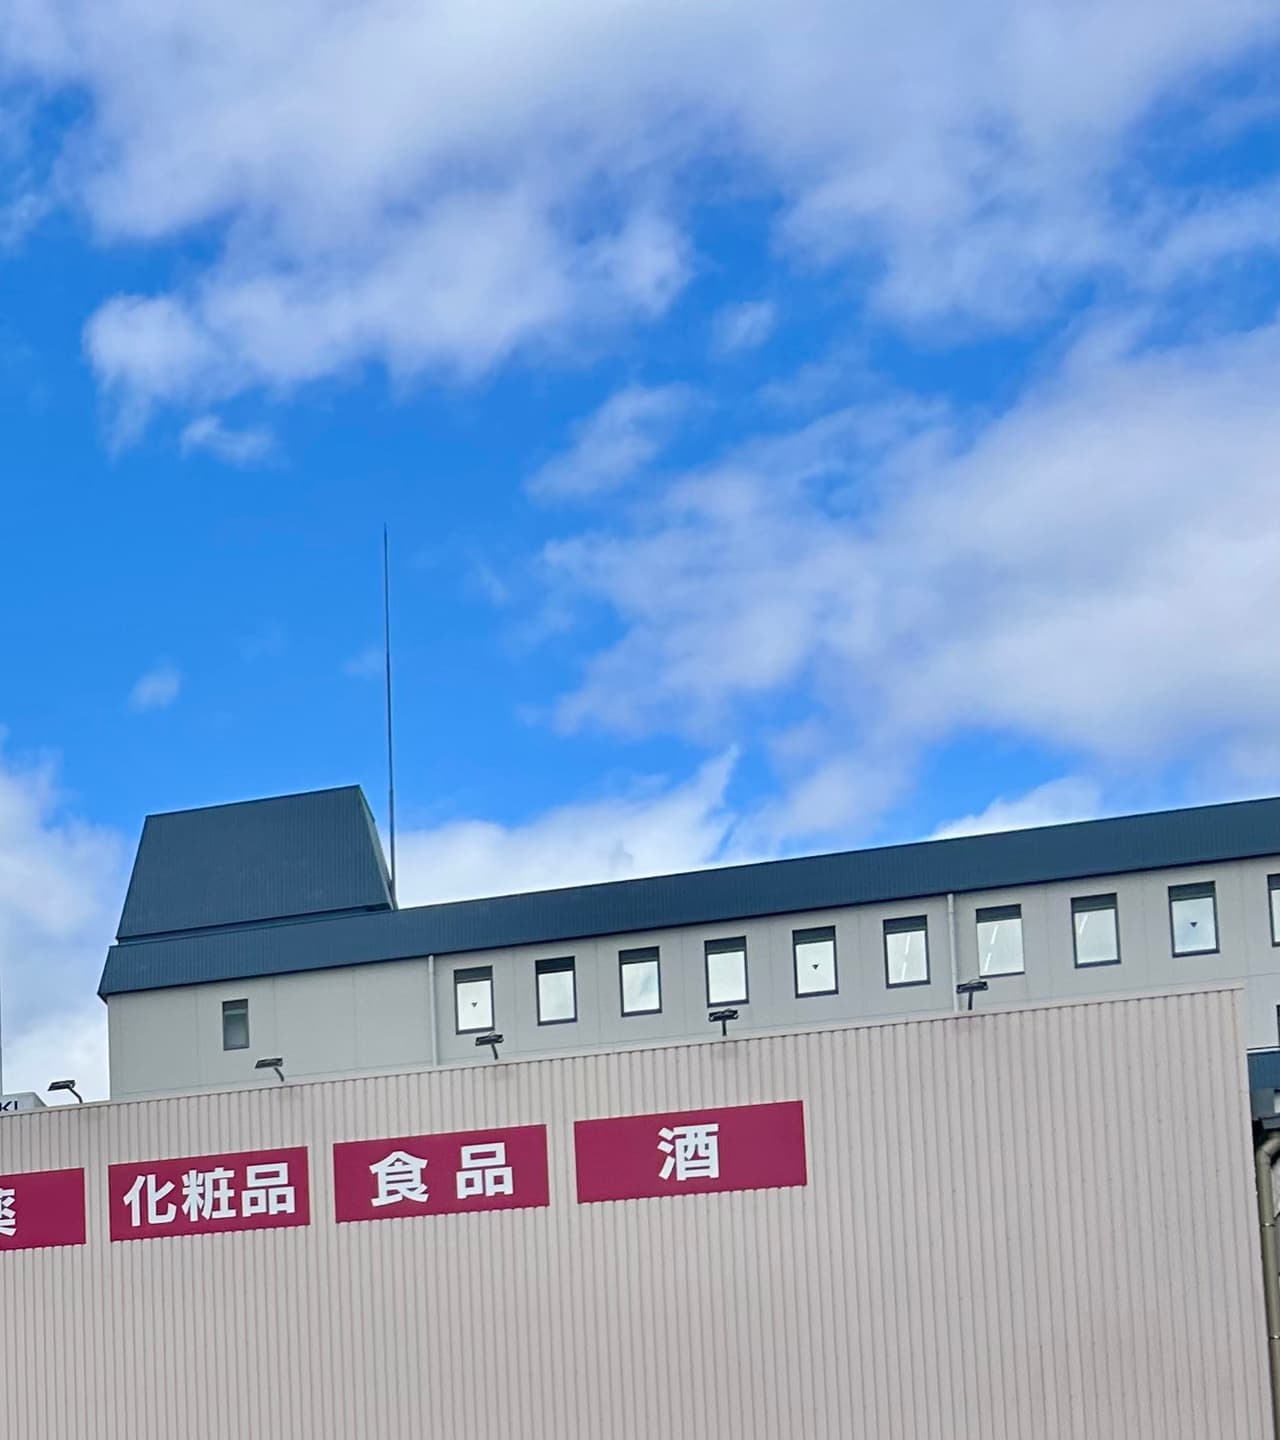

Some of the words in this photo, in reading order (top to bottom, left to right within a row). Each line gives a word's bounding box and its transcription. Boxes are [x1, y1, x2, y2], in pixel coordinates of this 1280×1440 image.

[369, 1142, 514, 1207] 食品
[657, 1123, 720, 1181] 酒
[123, 1162, 296, 1227] 化粧品
